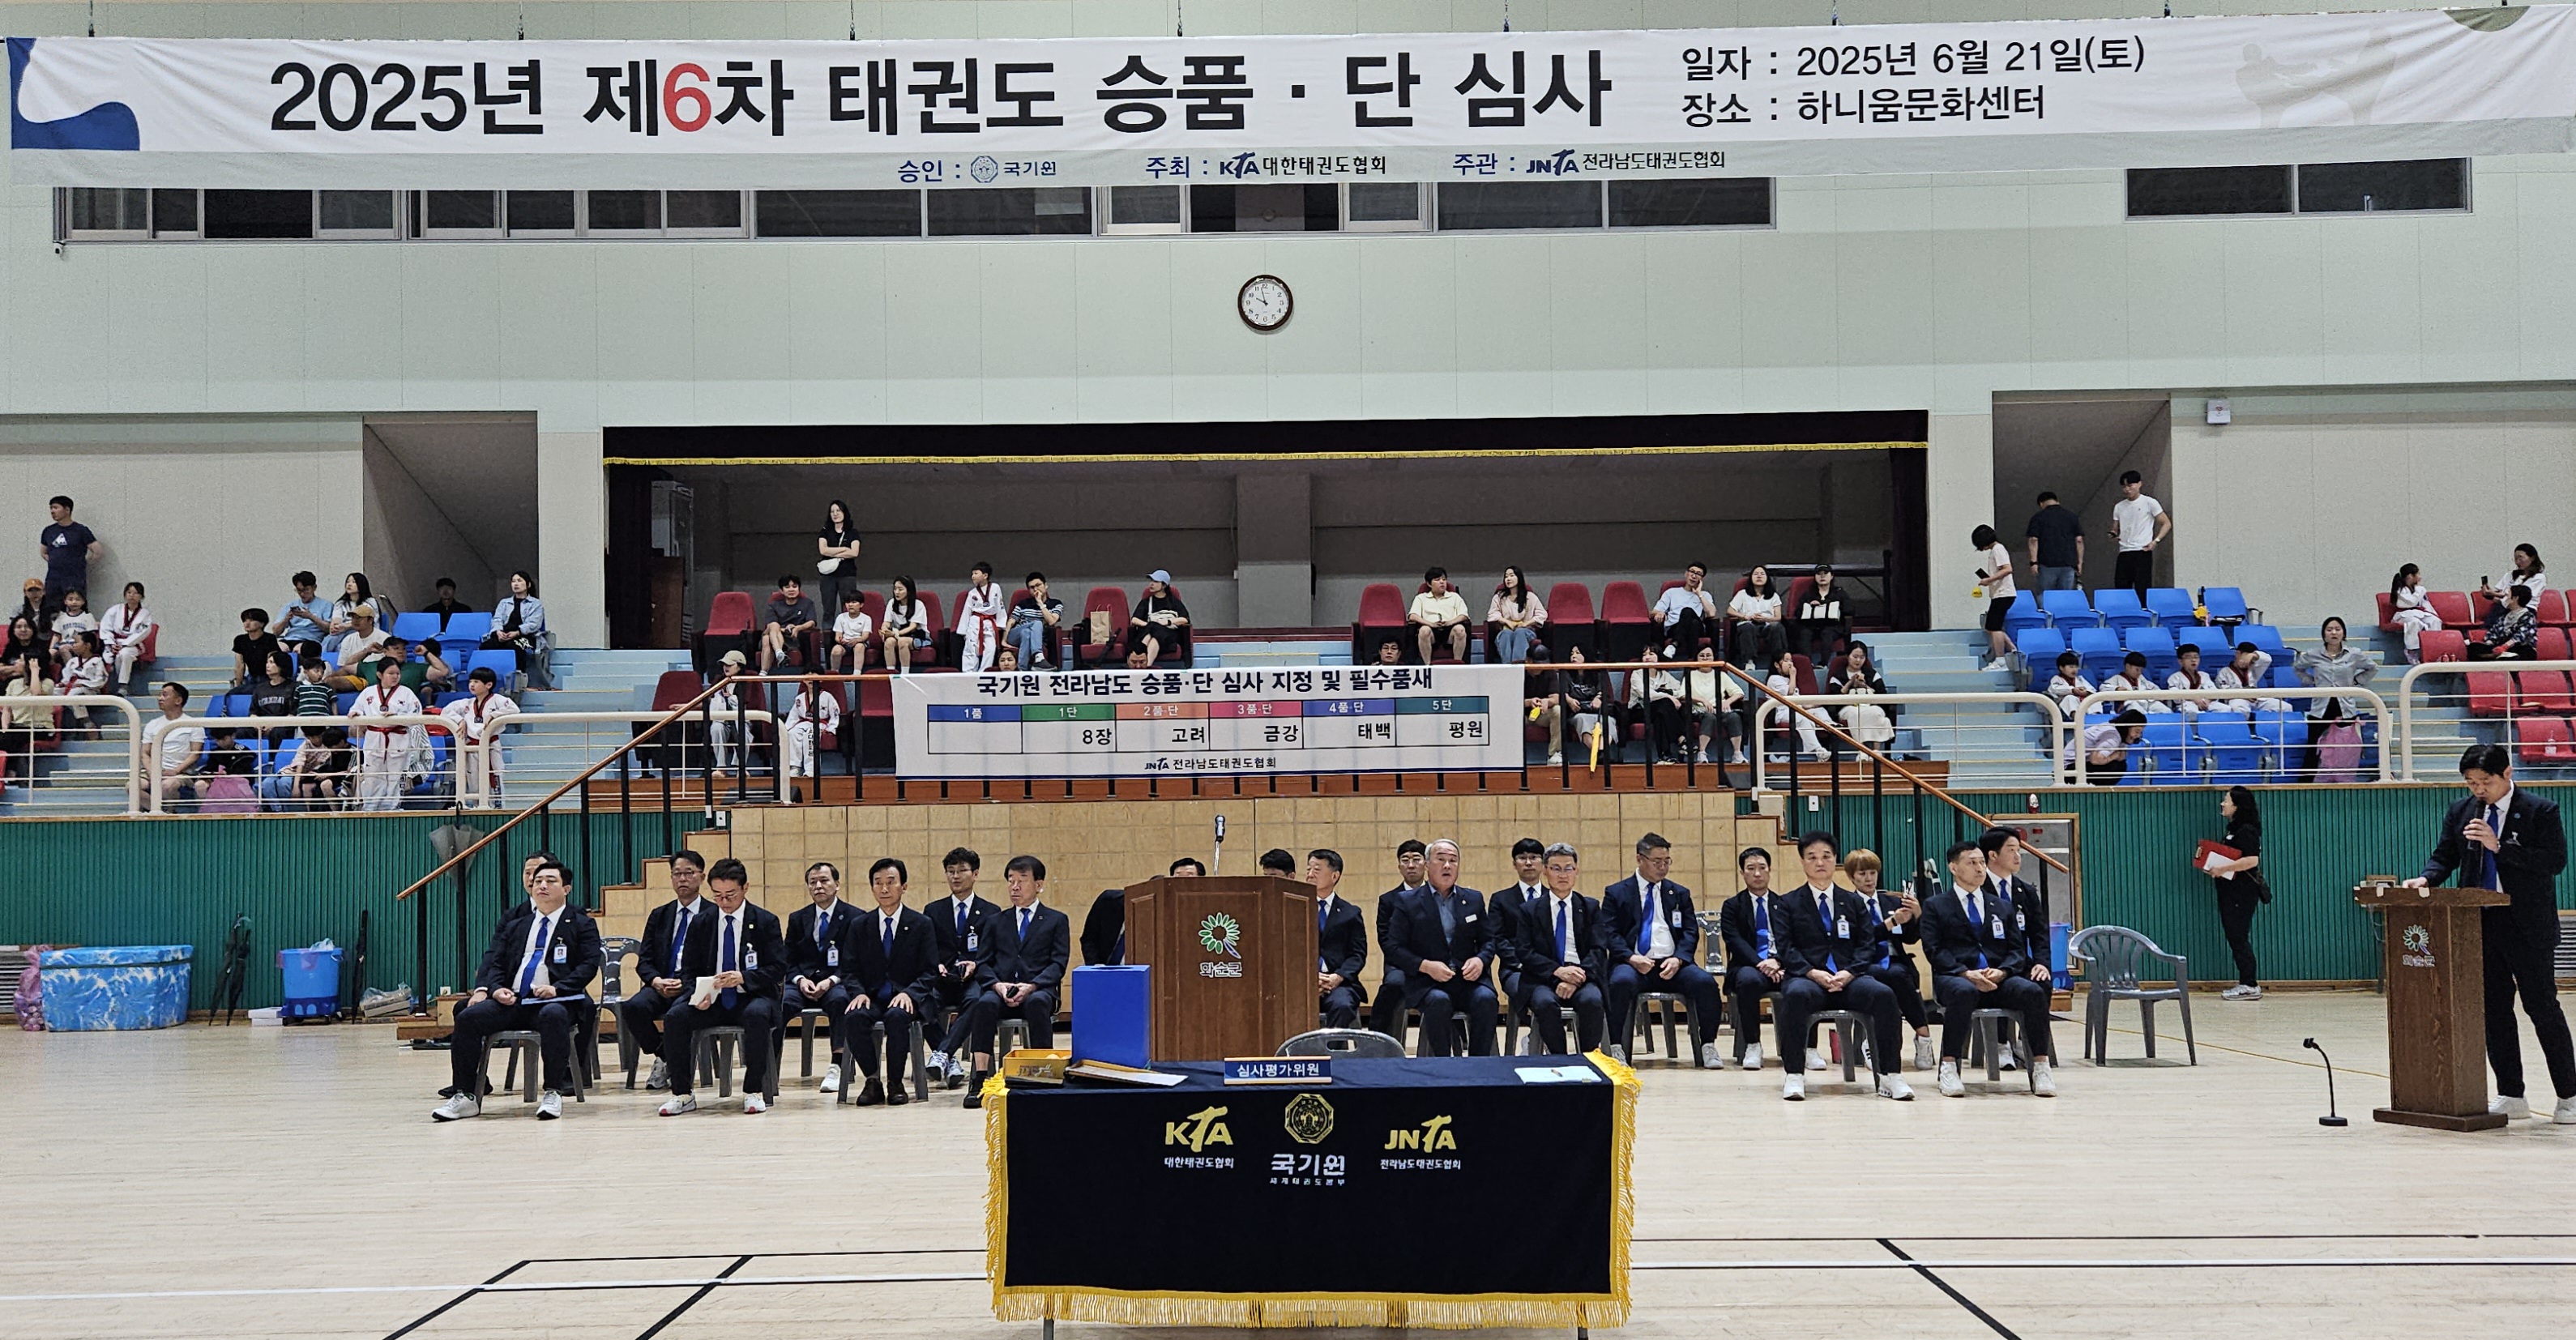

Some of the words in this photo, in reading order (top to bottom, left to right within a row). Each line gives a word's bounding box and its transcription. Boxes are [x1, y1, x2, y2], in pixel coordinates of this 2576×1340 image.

[1683, 46, 1751, 81] 일자
[1798, 42, 1916, 75] 2025년
[1933, 41, 1988, 74] 6월
[2006, 36, 2143, 73] 21일(토)
[271, 60, 543, 134] 2025년
[583, 60, 793, 136] 제6차
[830, 58, 1063, 135] 태권도
[1096, 56, 1253, 133] 승품
[1347, 53, 1420, 127] 단
[1455, 50, 1612, 127] 심사
[1682, 93, 1751, 127] 장소
[1798, 85, 2043, 124] 하니움문화센터
[898, 160, 942, 182] 승인
[1004, 161, 1056, 176] 국기원
[1146, 156, 1189, 178] 주최
[1220, 152, 1260, 178] KTA
[1263, 156, 1385, 176] 대한태권도협회
[1453, 153, 1497, 175] 주관
[1527, 149, 1579, 176] JNTA
[1583, 151, 1724, 170] 전라남도태권도협회
[977, 675, 1040, 697] 국기원
[1049, 674, 1132, 695] 전라남도
[1141, 672, 1213, 695] 승품·단
[1221, 672, 1263, 693] 심사
[1272, 671, 1312, 692] 지정
[1322, 670, 1340, 691] 및
[1350, 668, 1432, 690] 필수품새
[964, 708, 982, 719] 1품
[1060, 707, 1077, 717] 1단
[1433, 700, 1451, 710] 5단
[1083, 728, 1112, 745] 8장
[1172, 727, 1204, 743] 고려
[1264, 725, 1298, 742] 금강
[1358, 723, 1390, 740] 태백
[1450, 721, 1482, 738] 평원
[1145, 757, 1169, 770] JNTA
[1173, 757, 1275, 770] 전라남도태권도협회
[1199, 961, 1242, 979] 화순군
[1237, 1063, 1320, 1078] 심사평가위원
[1165, 1107, 1233, 1152] KTA
[1385, 1116, 1456, 1152] JNTA
[1164, 1157, 1233, 1168] 대한태권도협회
[1271, 1154, 1344, 1176] 국기원
